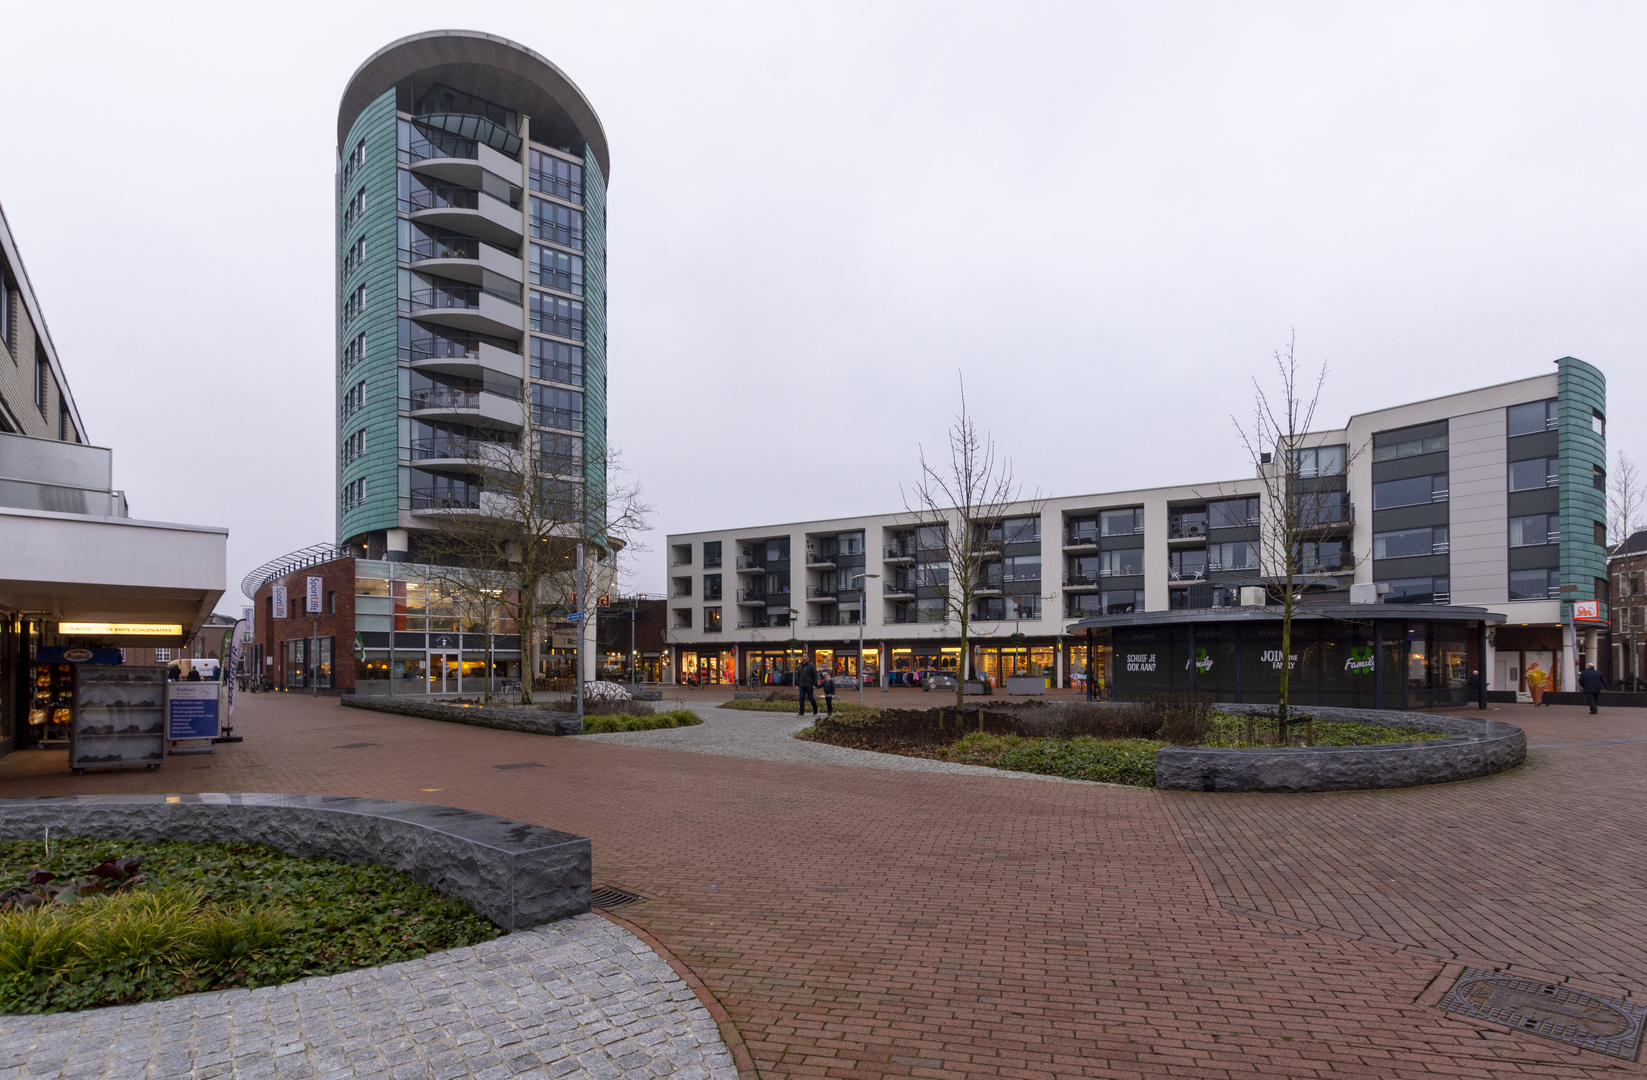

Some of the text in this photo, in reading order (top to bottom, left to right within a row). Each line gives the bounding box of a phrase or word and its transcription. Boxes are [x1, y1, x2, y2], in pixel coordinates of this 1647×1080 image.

[1127, 654, 1156, 662] SCHUIF JE
[1127, 663, 1156, 671] OOK AAN?
